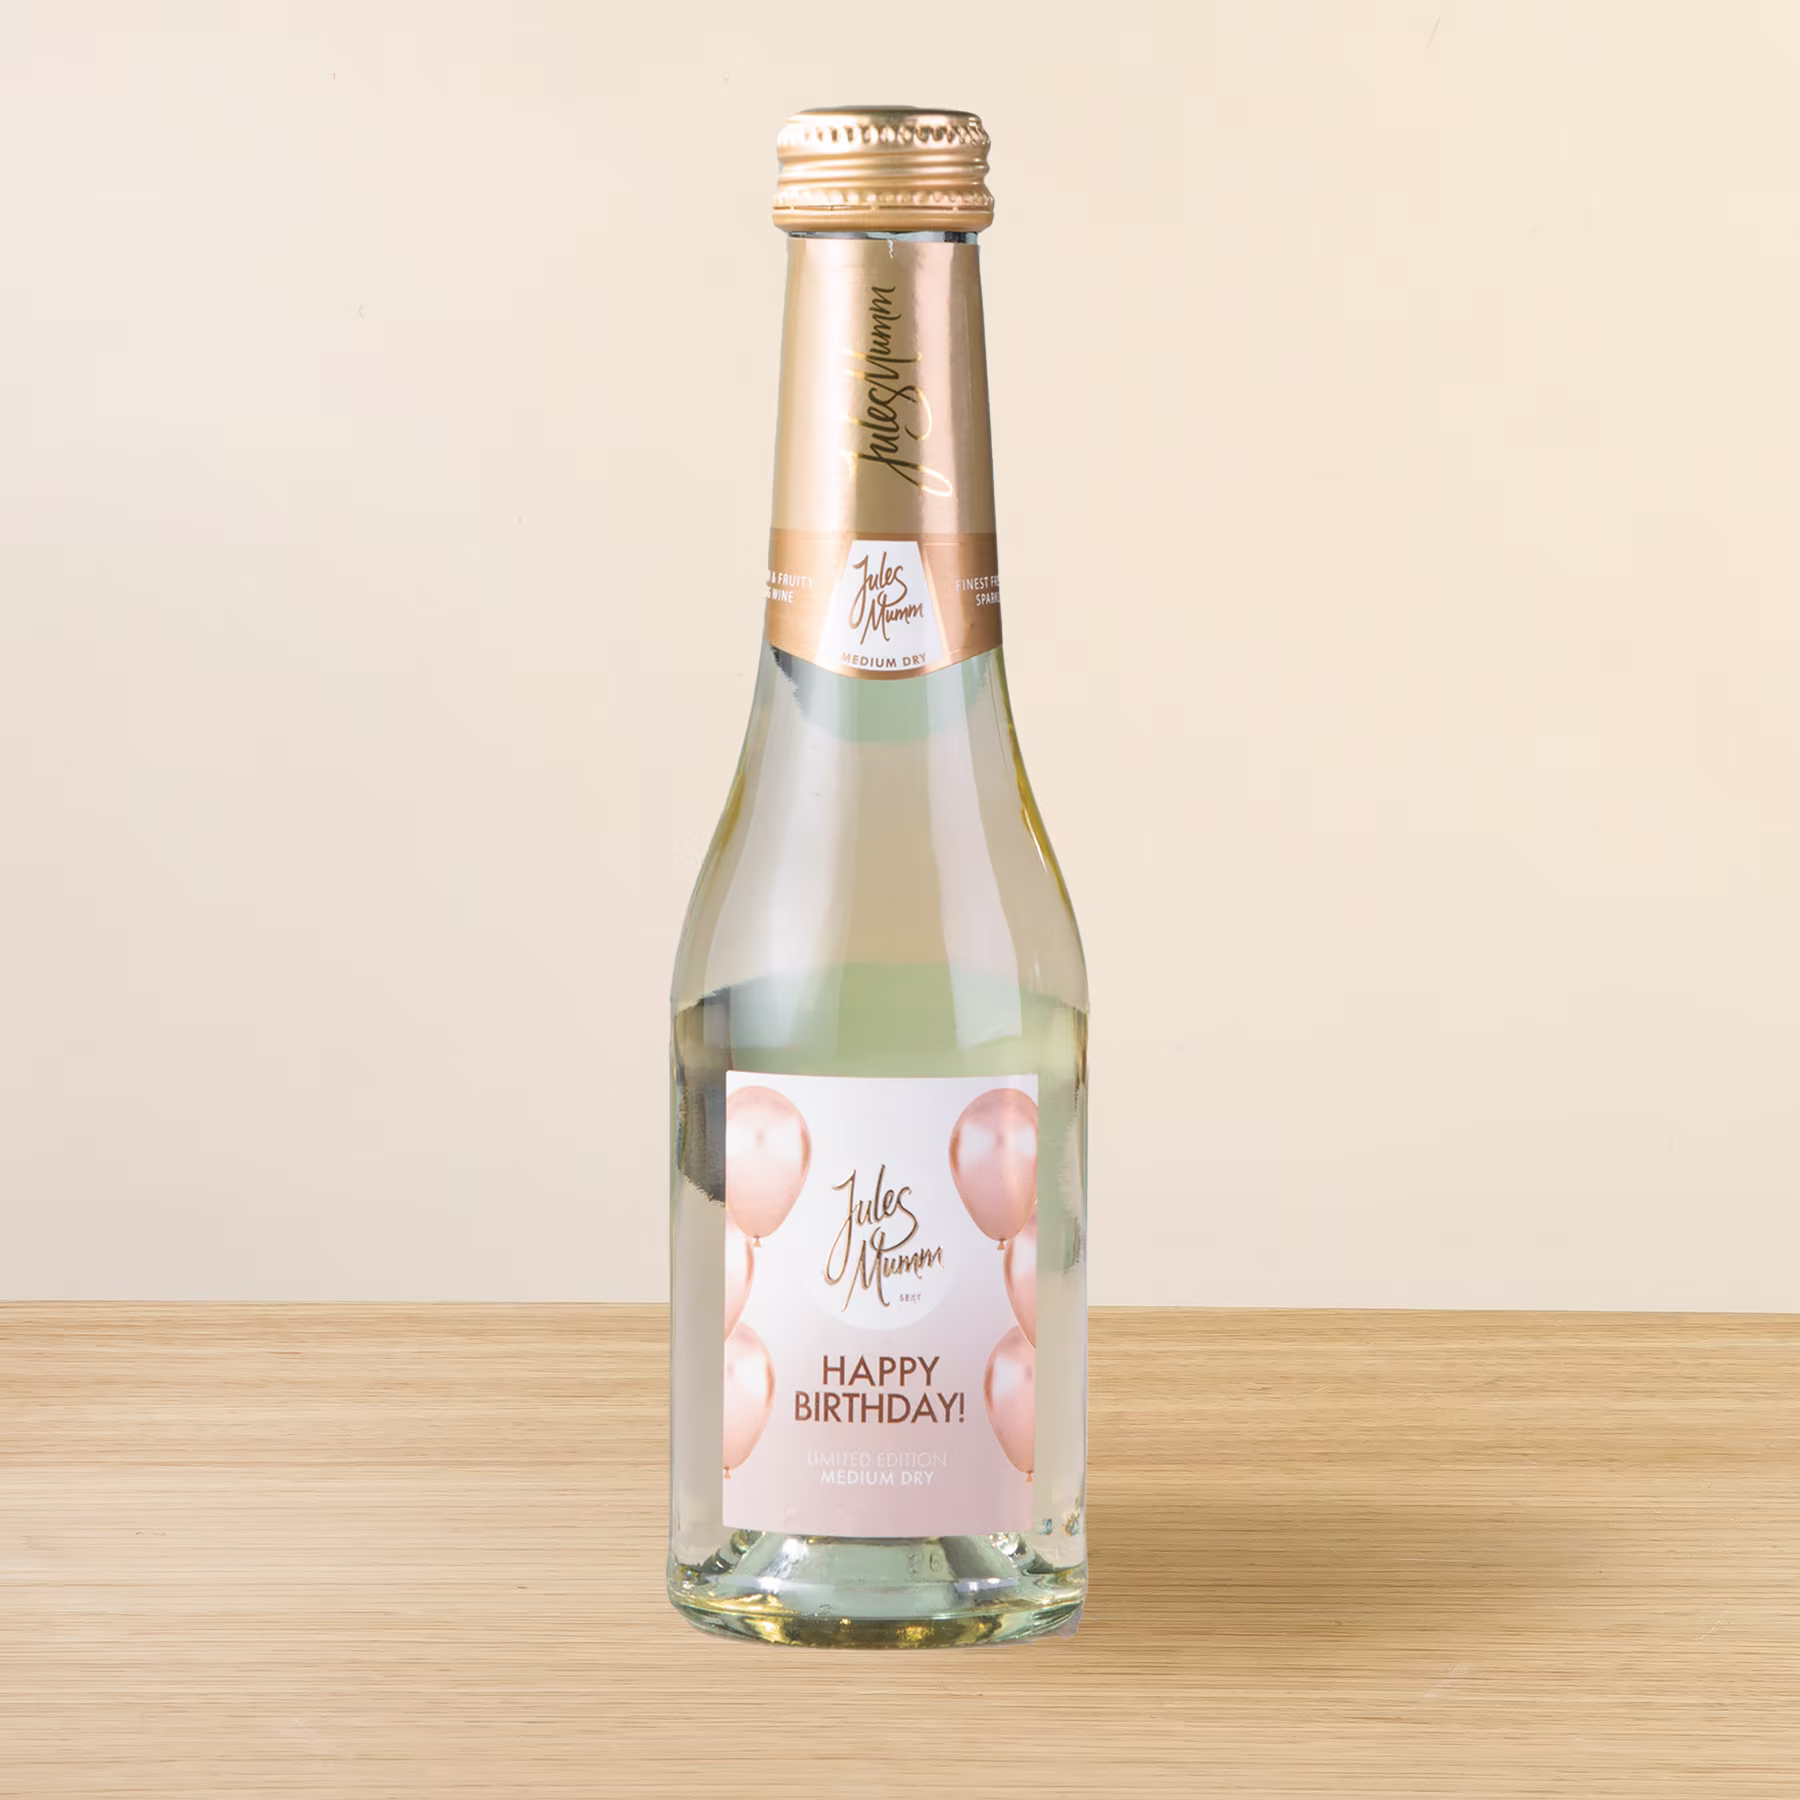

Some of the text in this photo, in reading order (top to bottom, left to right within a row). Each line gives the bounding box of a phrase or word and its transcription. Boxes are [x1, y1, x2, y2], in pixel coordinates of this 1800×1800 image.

[840, 286, 953, 497] Jules Mumm
[771, 588, 793, 603] WINE
[777, 571, 815, 589] FRUITY
[849, 551, 908, 629] Jules
[955, 576, 989, 592] FINEST
[859, 593, 924, 645] Mumm
[840, 651, 927, 669] MEDIUM DRY
[824, 1164, 919, 1286] Jules
[841, 1229, 945, 1312] Mumm
[821, 1355, 941, 1387] HAPPY
[794, 1390, 966, 1424] BIRTHDAY!
[807, 1450, 948, 1468] LIMITED EDITION
[820, 1469, 935, 1486] MEDIUM DRY
